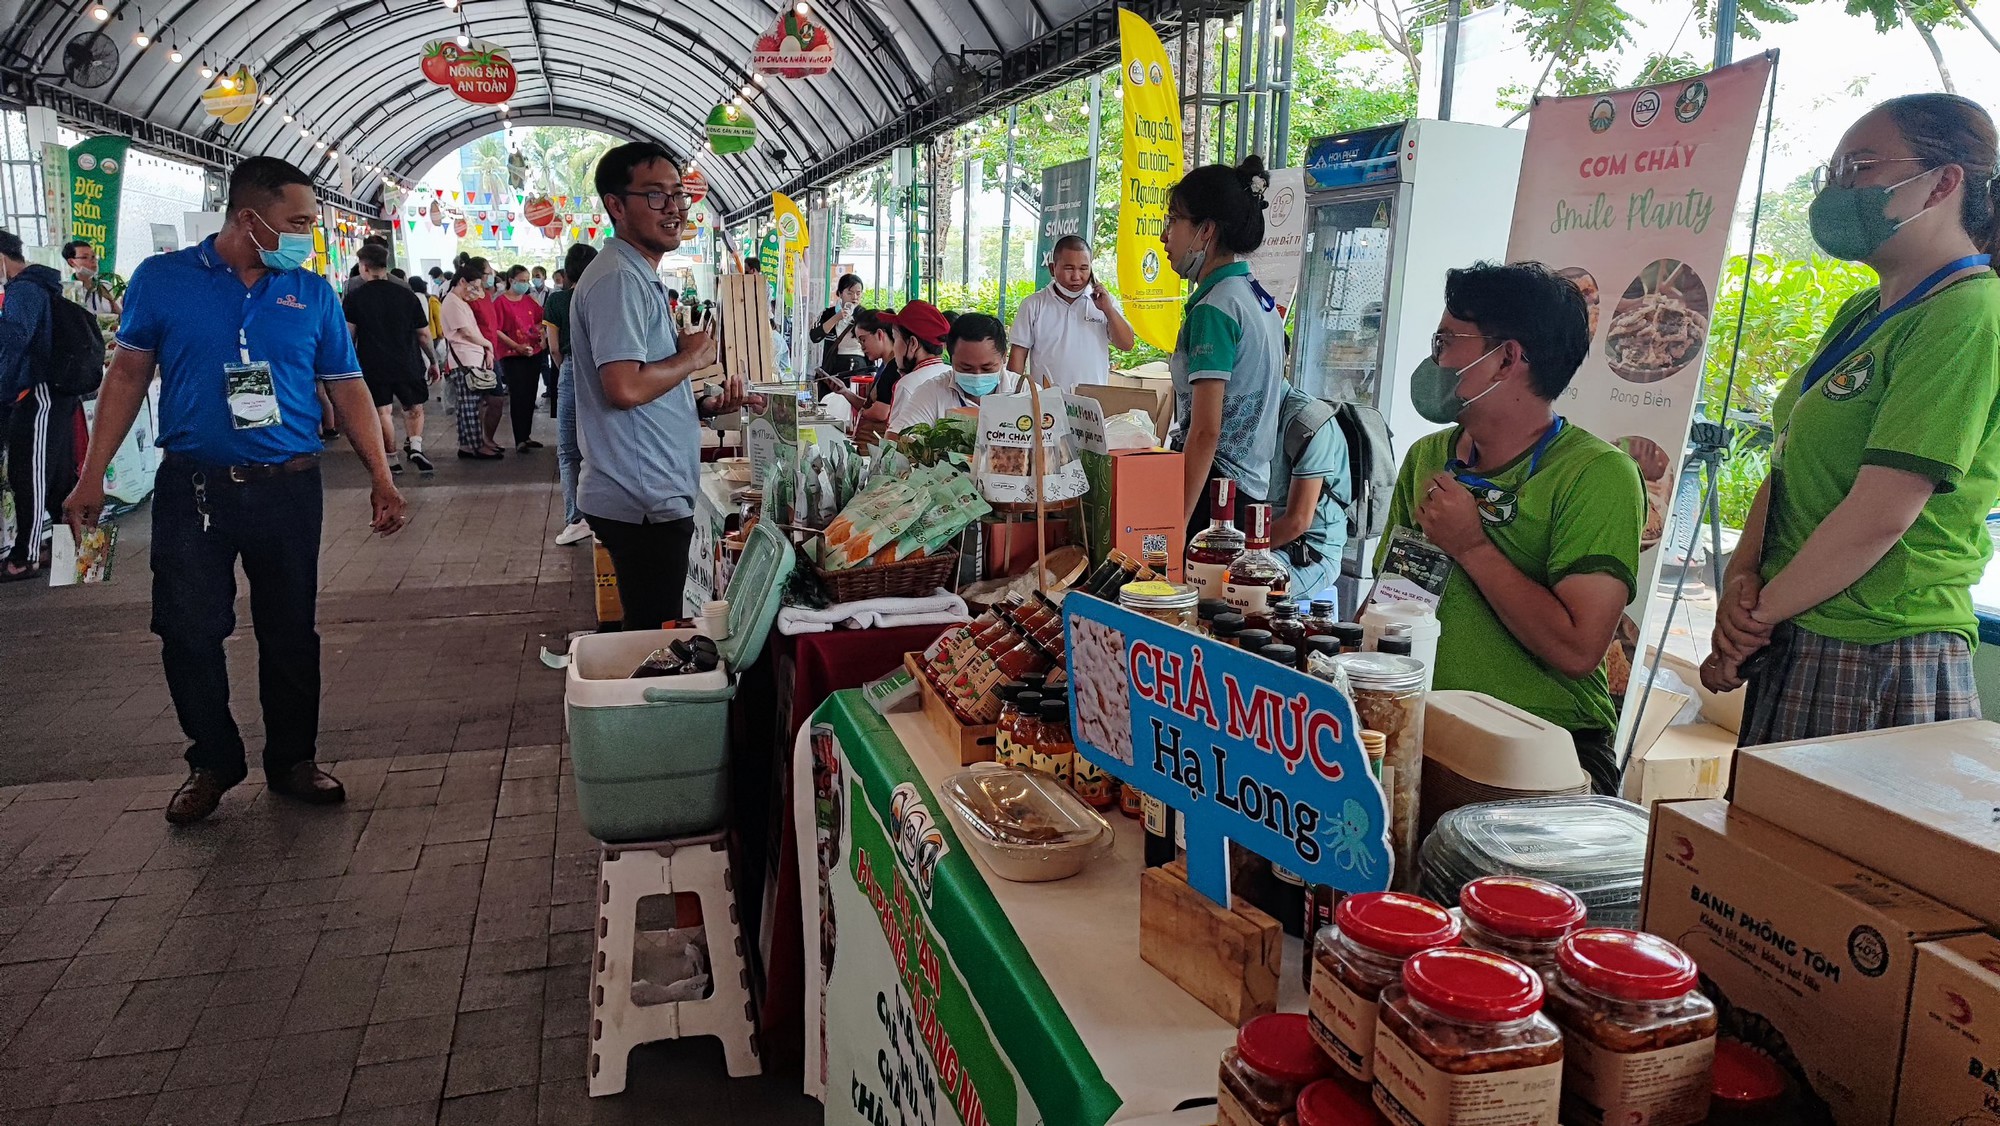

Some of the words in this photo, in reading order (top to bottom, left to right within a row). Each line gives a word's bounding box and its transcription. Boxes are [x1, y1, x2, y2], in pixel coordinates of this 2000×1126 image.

[449, 65, 483, 78] NÔNG
[485, 63, 509, 78] SẢN
[457, 81, 474, 92] AN
[476, 80, 507, 93] TOÀN
[1579, 152, 1628, 178] CƠM
[1634, 140, 1698, 173] CHÁY
[74, 176, 104, 199] Đặc
[74, 200, 101, 219] sản
[1550, 191, 1617, 234] Smile
[1627, 187, 1715, 235] Planty
[1610, 387, 1639, 407] Rong
[1643, 388, 1672, 408] Biển
[1129, 639, 1220, 731] CHẢ
[1222, 672, 1345, 783] MỰC
[1149, 715, 1206, 801] Hạ
[1211, 744, 1322, 864] Long
[1802, 946, 1841, 984] TÔM
